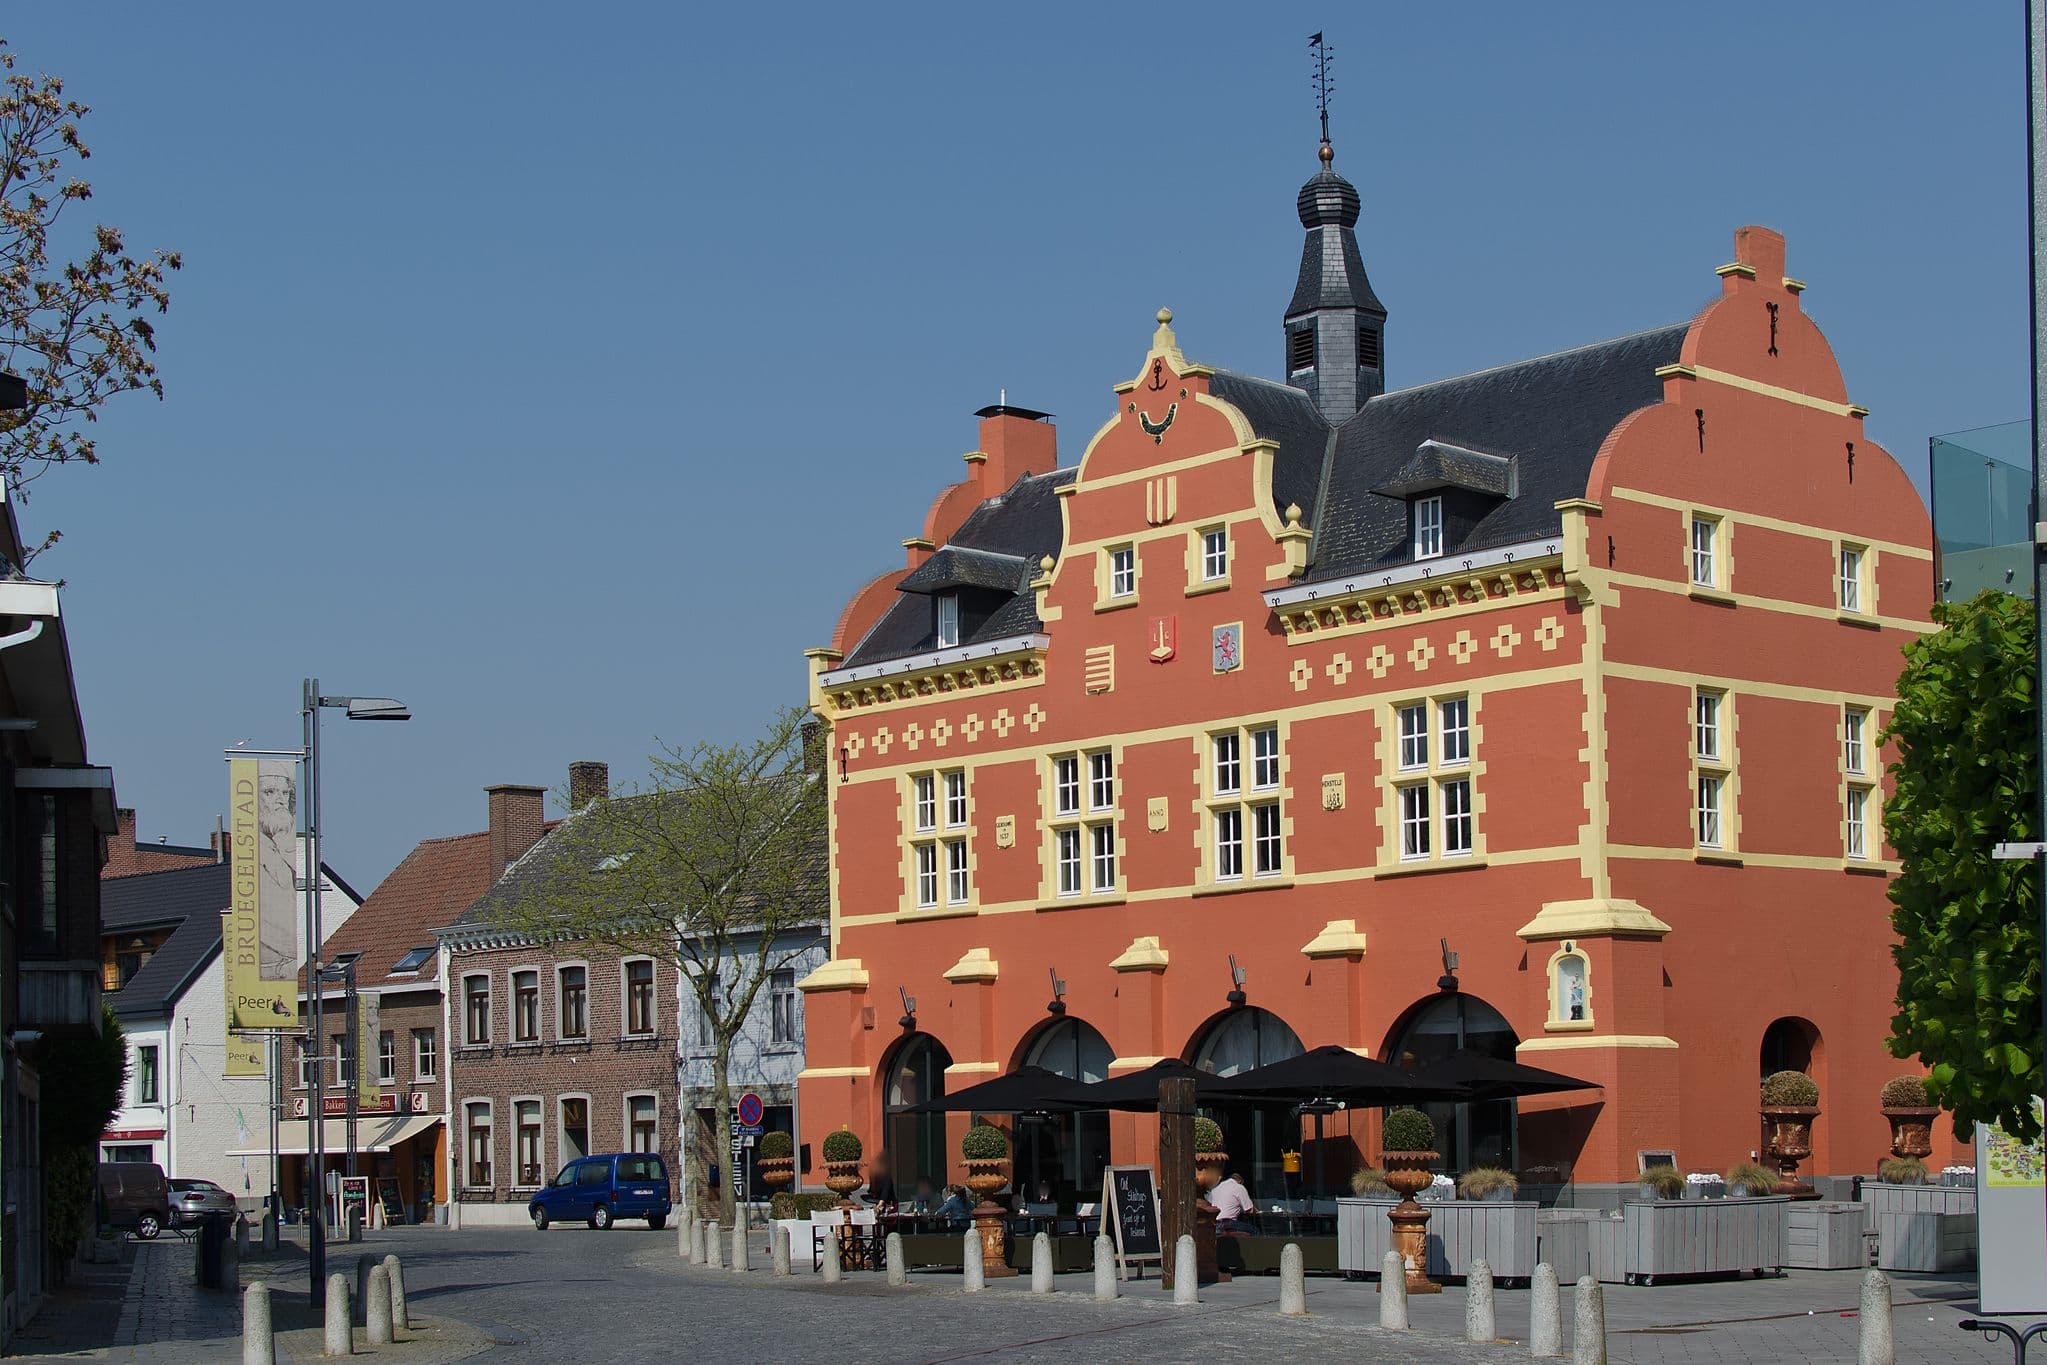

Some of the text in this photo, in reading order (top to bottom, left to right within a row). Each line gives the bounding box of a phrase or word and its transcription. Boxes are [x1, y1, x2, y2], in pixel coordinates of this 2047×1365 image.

[237, 779, 255, 967] BRUEGELSTAD
[238, 995, 272, 1009] Peer
[228, 1052, 249, 1061] Peer
